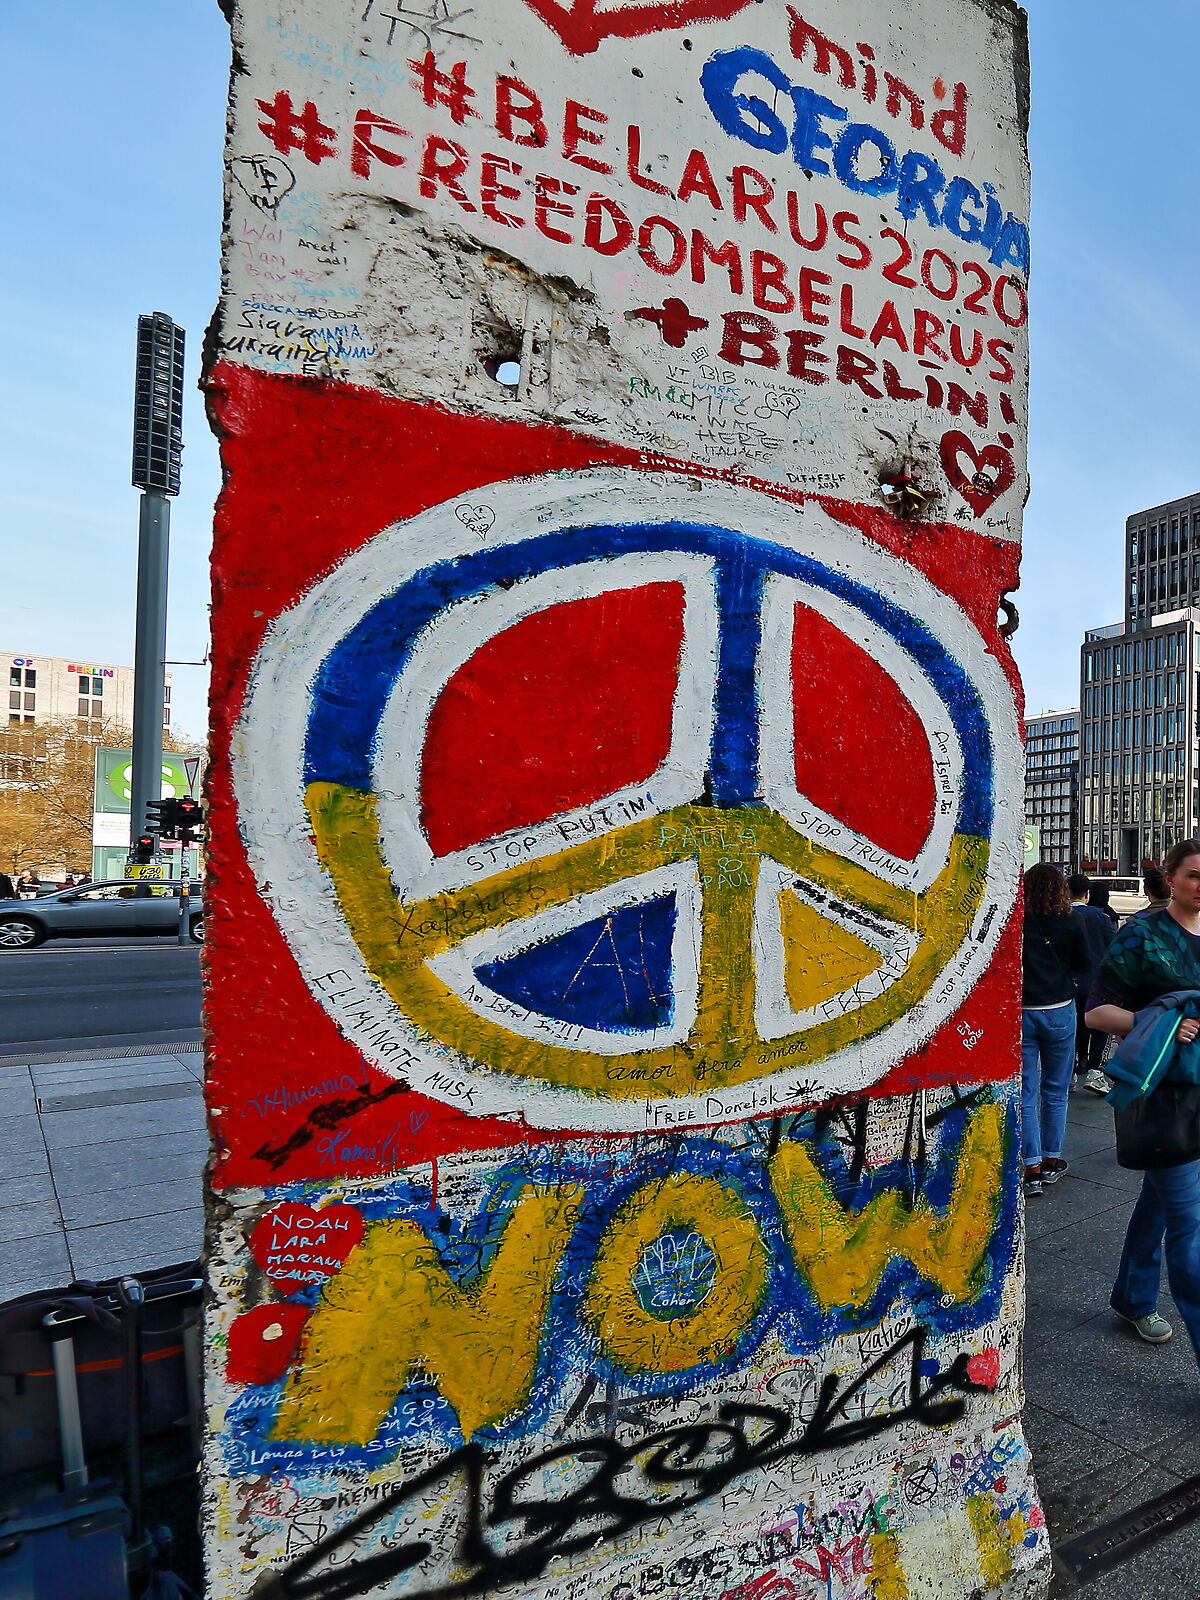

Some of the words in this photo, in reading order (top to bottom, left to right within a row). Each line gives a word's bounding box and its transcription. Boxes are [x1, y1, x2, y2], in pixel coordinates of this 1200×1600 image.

[787, 4, 968, 157] mind
[67, 665, 114, 677] BERLIN
[795, 811, 842, 839] STOP
[466, 836, 537, 872] STOP
[424, 1071, 480, 1106] MUSK
[653, 1105, 697, 1127] FREE
[270, 1098, 1005, 1449] NOW
